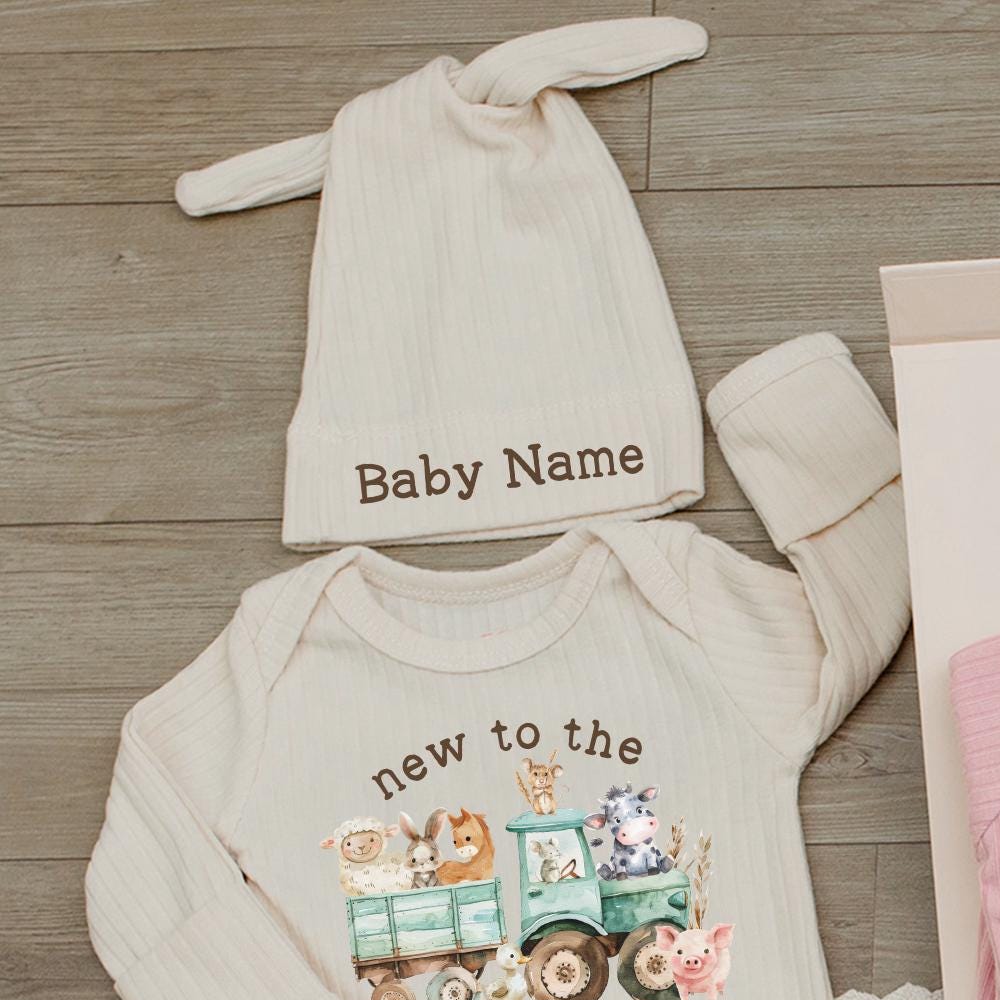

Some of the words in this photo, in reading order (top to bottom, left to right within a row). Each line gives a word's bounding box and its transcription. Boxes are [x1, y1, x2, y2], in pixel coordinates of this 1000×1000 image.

[354, 453, 484, 505] Baby
[502, 443, 644, 489] Name
[371, 732, 466, 801] new
[490, 719, 541, 752] to
[563, 718, 643, 765] the
